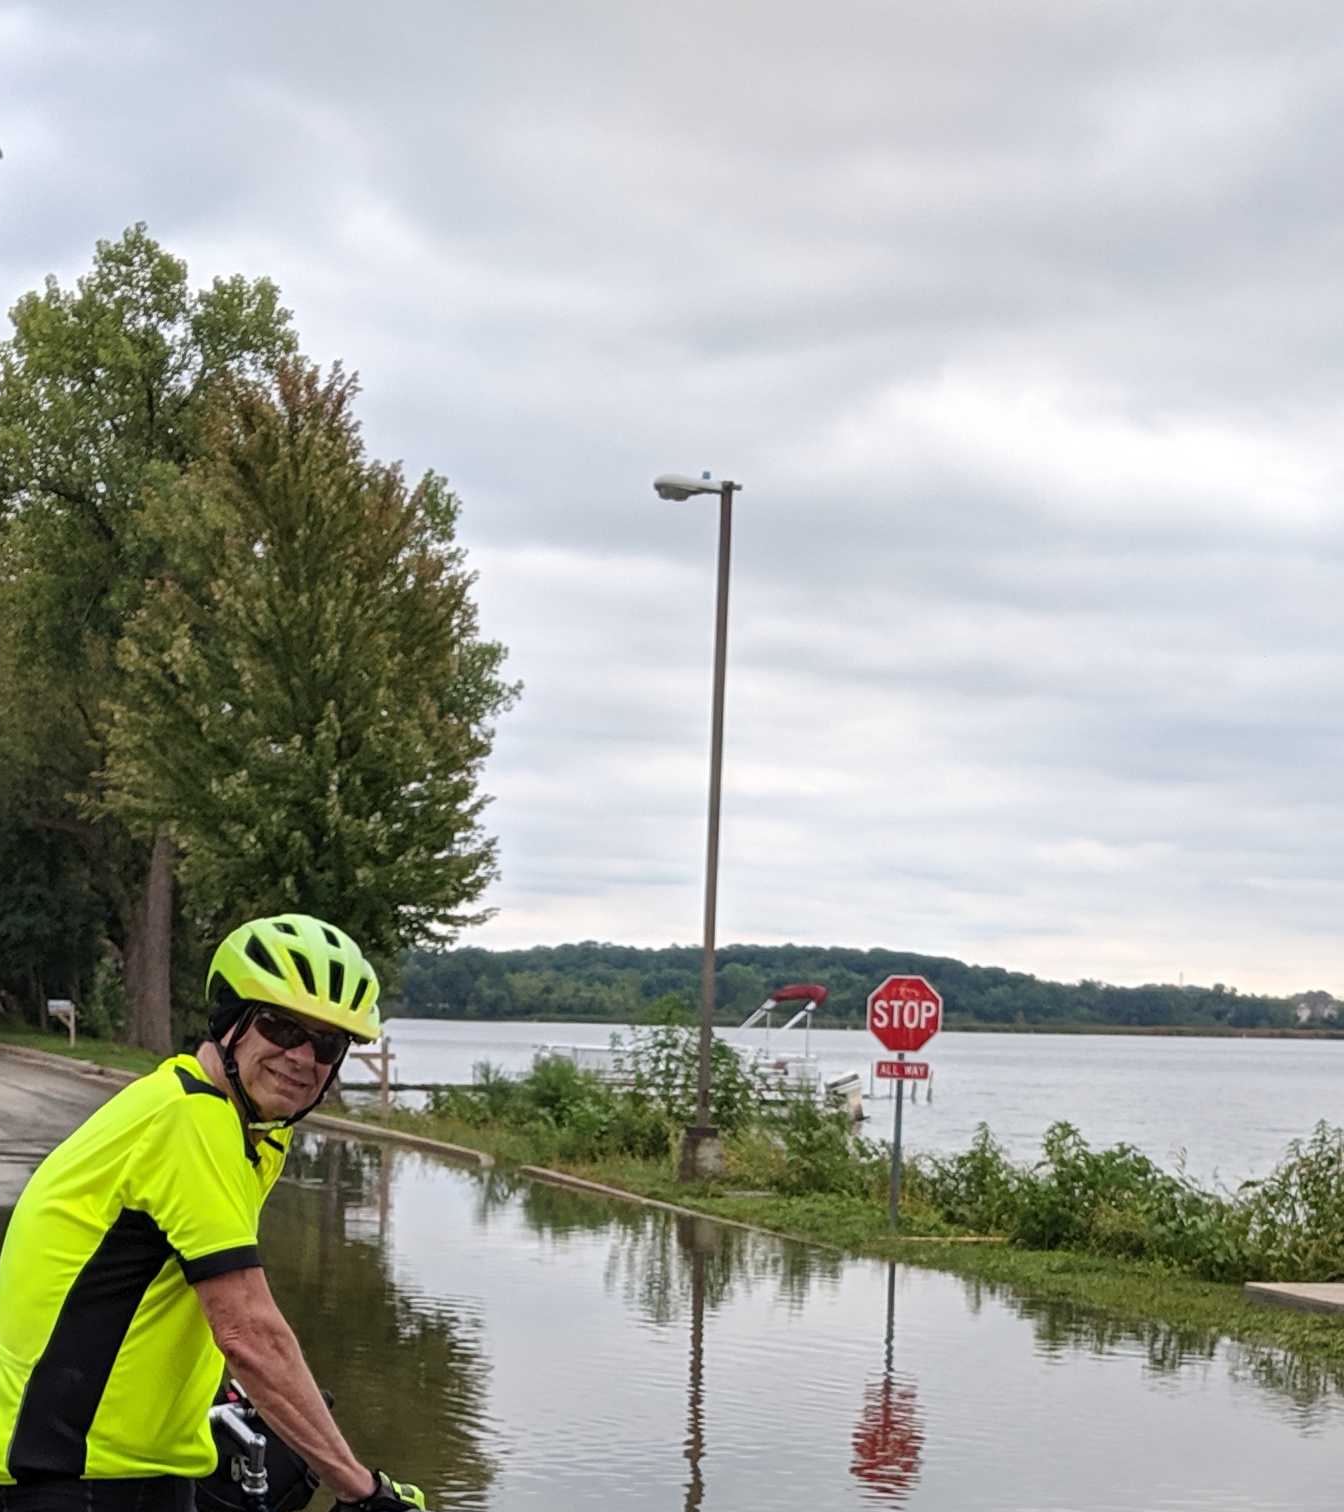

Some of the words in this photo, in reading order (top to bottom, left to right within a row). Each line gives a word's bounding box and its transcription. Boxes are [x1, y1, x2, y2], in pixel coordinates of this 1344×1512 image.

[873, 1000, 937, 1029] STOP
[879, 1064, 900, 1076] ALL
[903, 1065, 925, 1076] WAY
